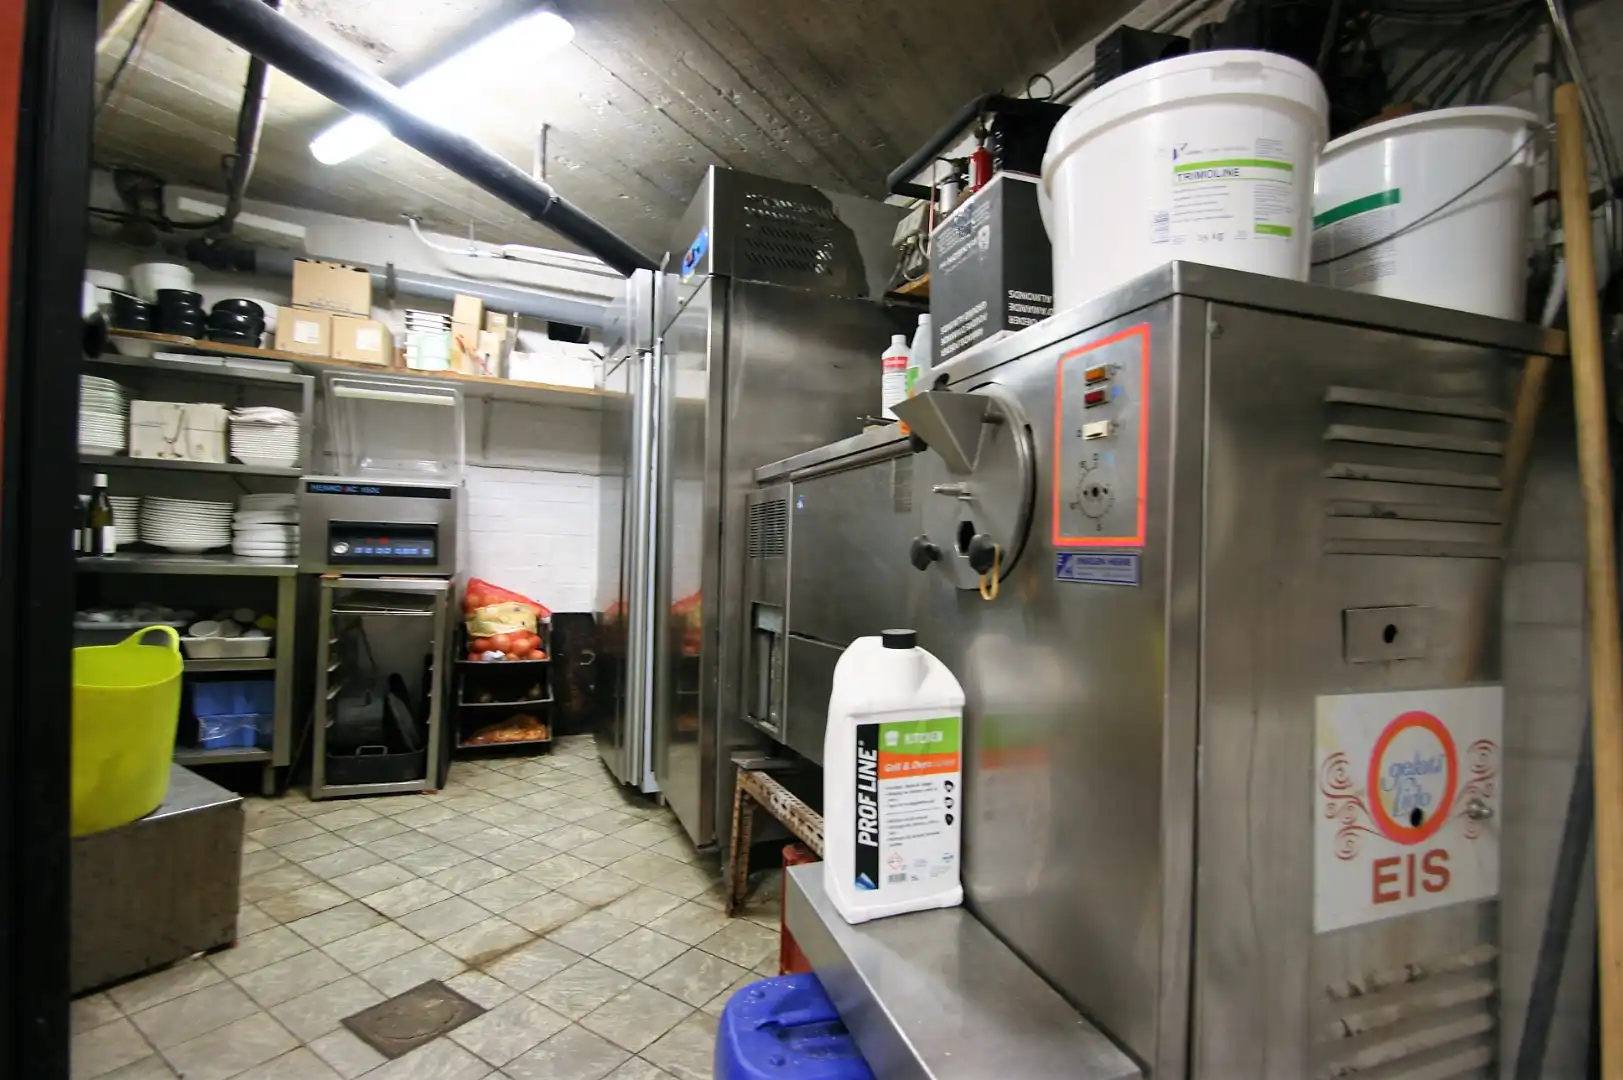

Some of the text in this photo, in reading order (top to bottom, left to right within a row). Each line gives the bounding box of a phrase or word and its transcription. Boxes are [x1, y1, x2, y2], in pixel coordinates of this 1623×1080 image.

[858, 747, 878, 847] PROF LINE
[1372, 849, 1451, 904] EIS
